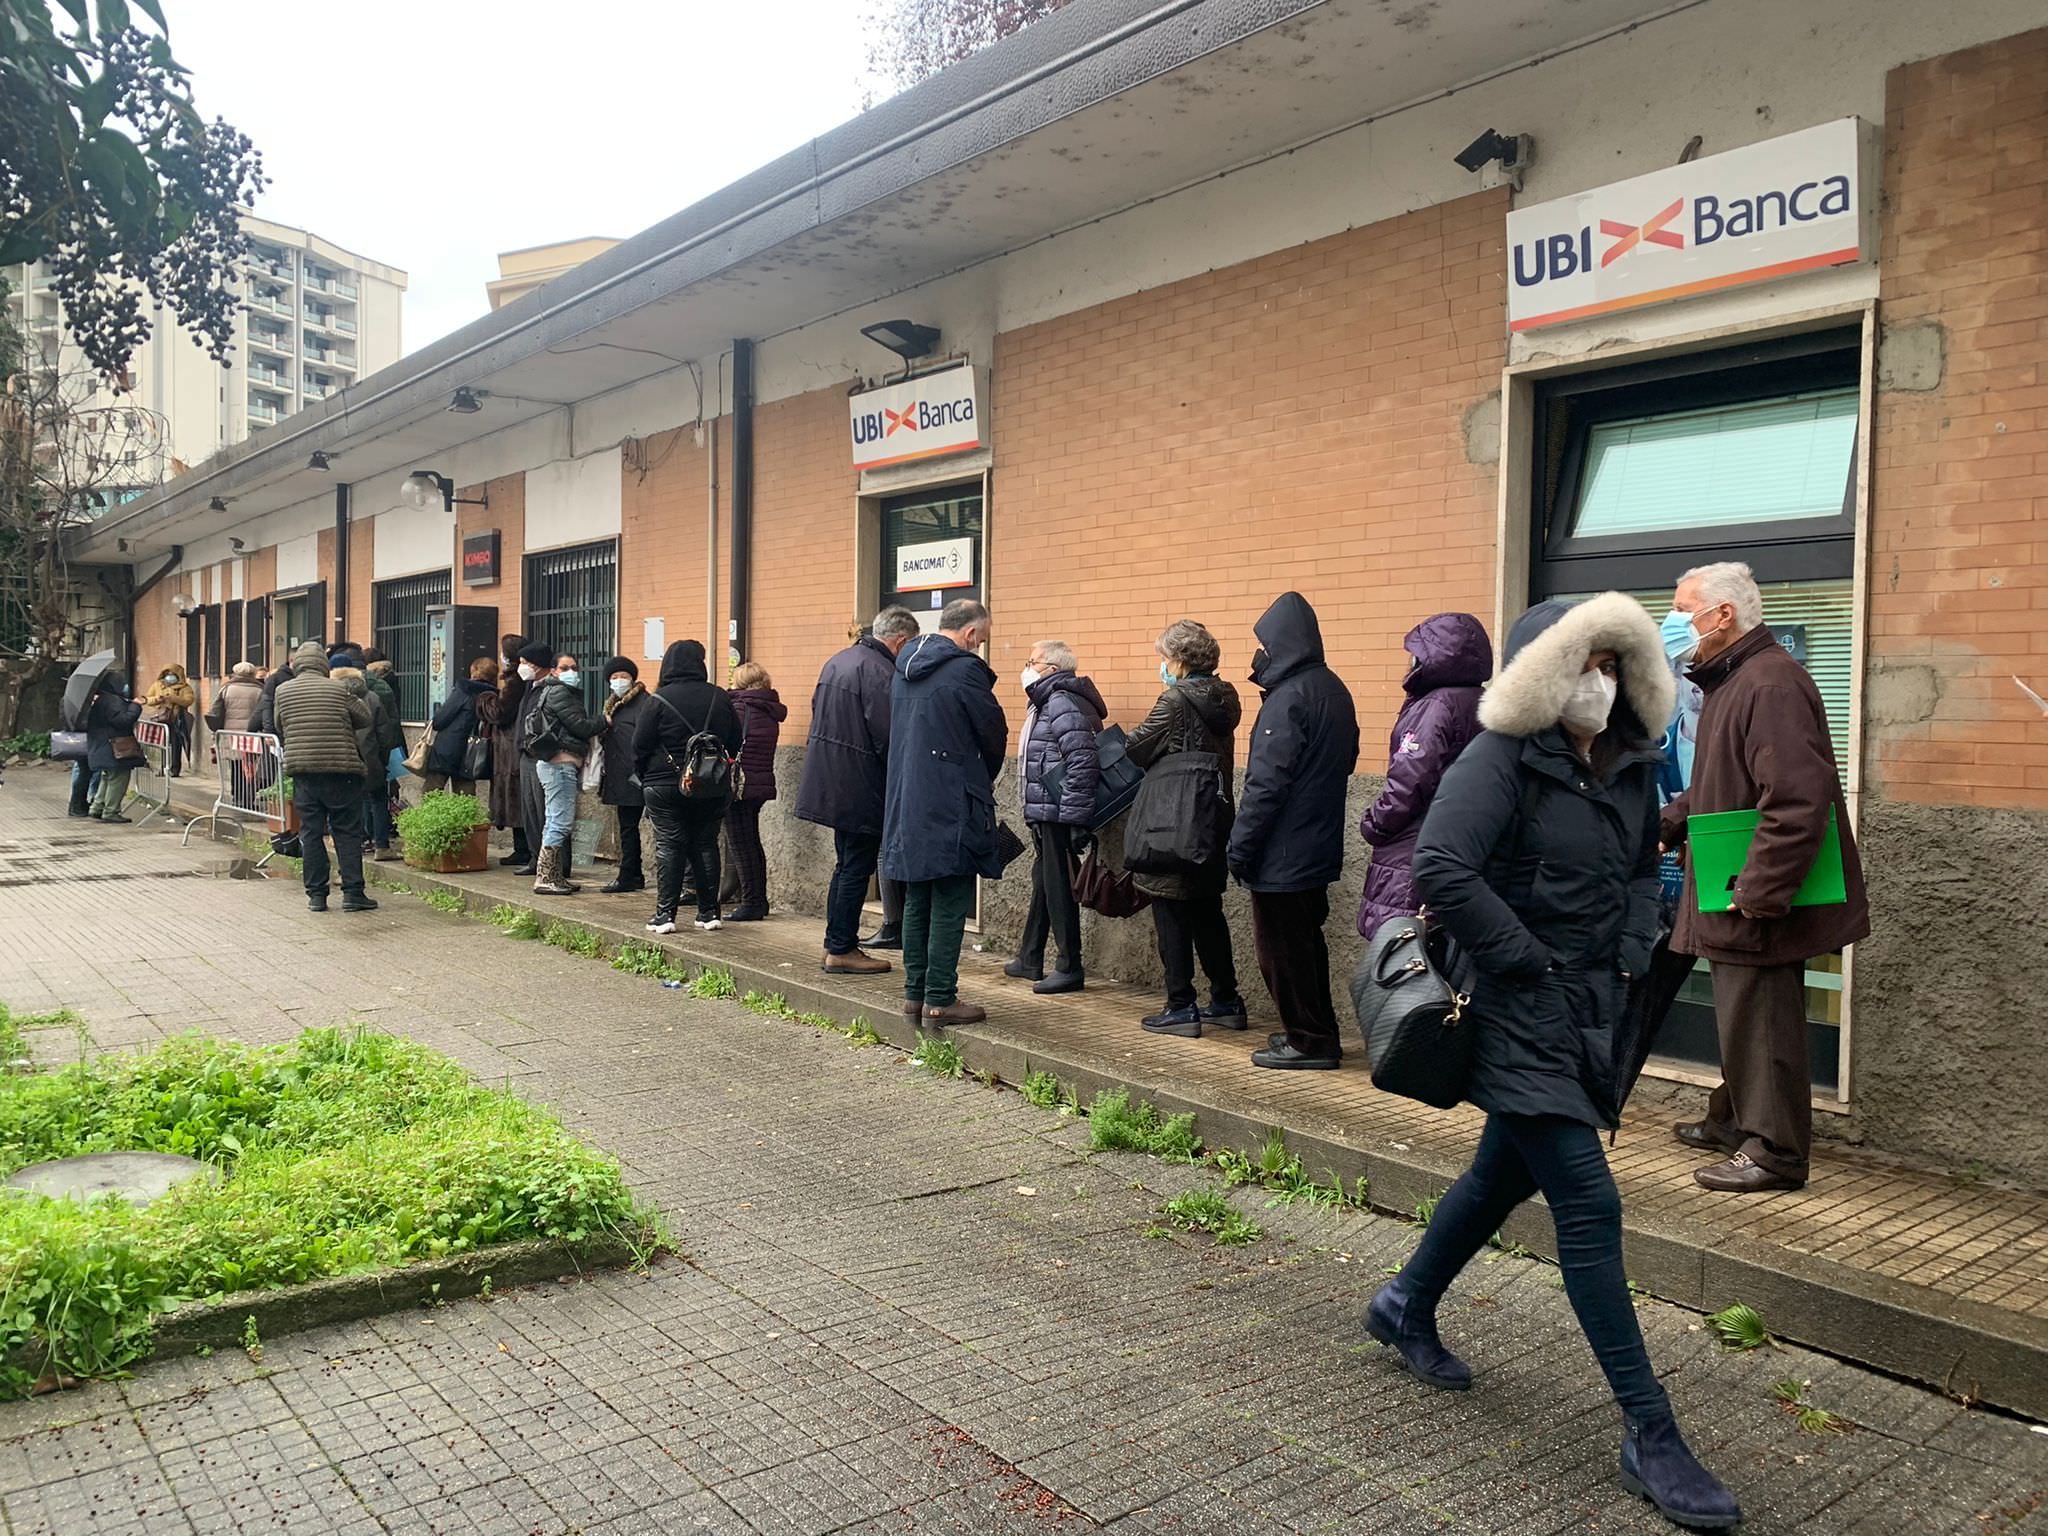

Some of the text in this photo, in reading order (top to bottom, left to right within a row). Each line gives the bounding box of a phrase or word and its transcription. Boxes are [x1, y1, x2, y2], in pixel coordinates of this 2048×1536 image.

[1513, 174, 1850, 287] UBI Banca
[853, 398, 974, 444] UBI Banca
[903, 556, 946, 572] BANCOMAT
